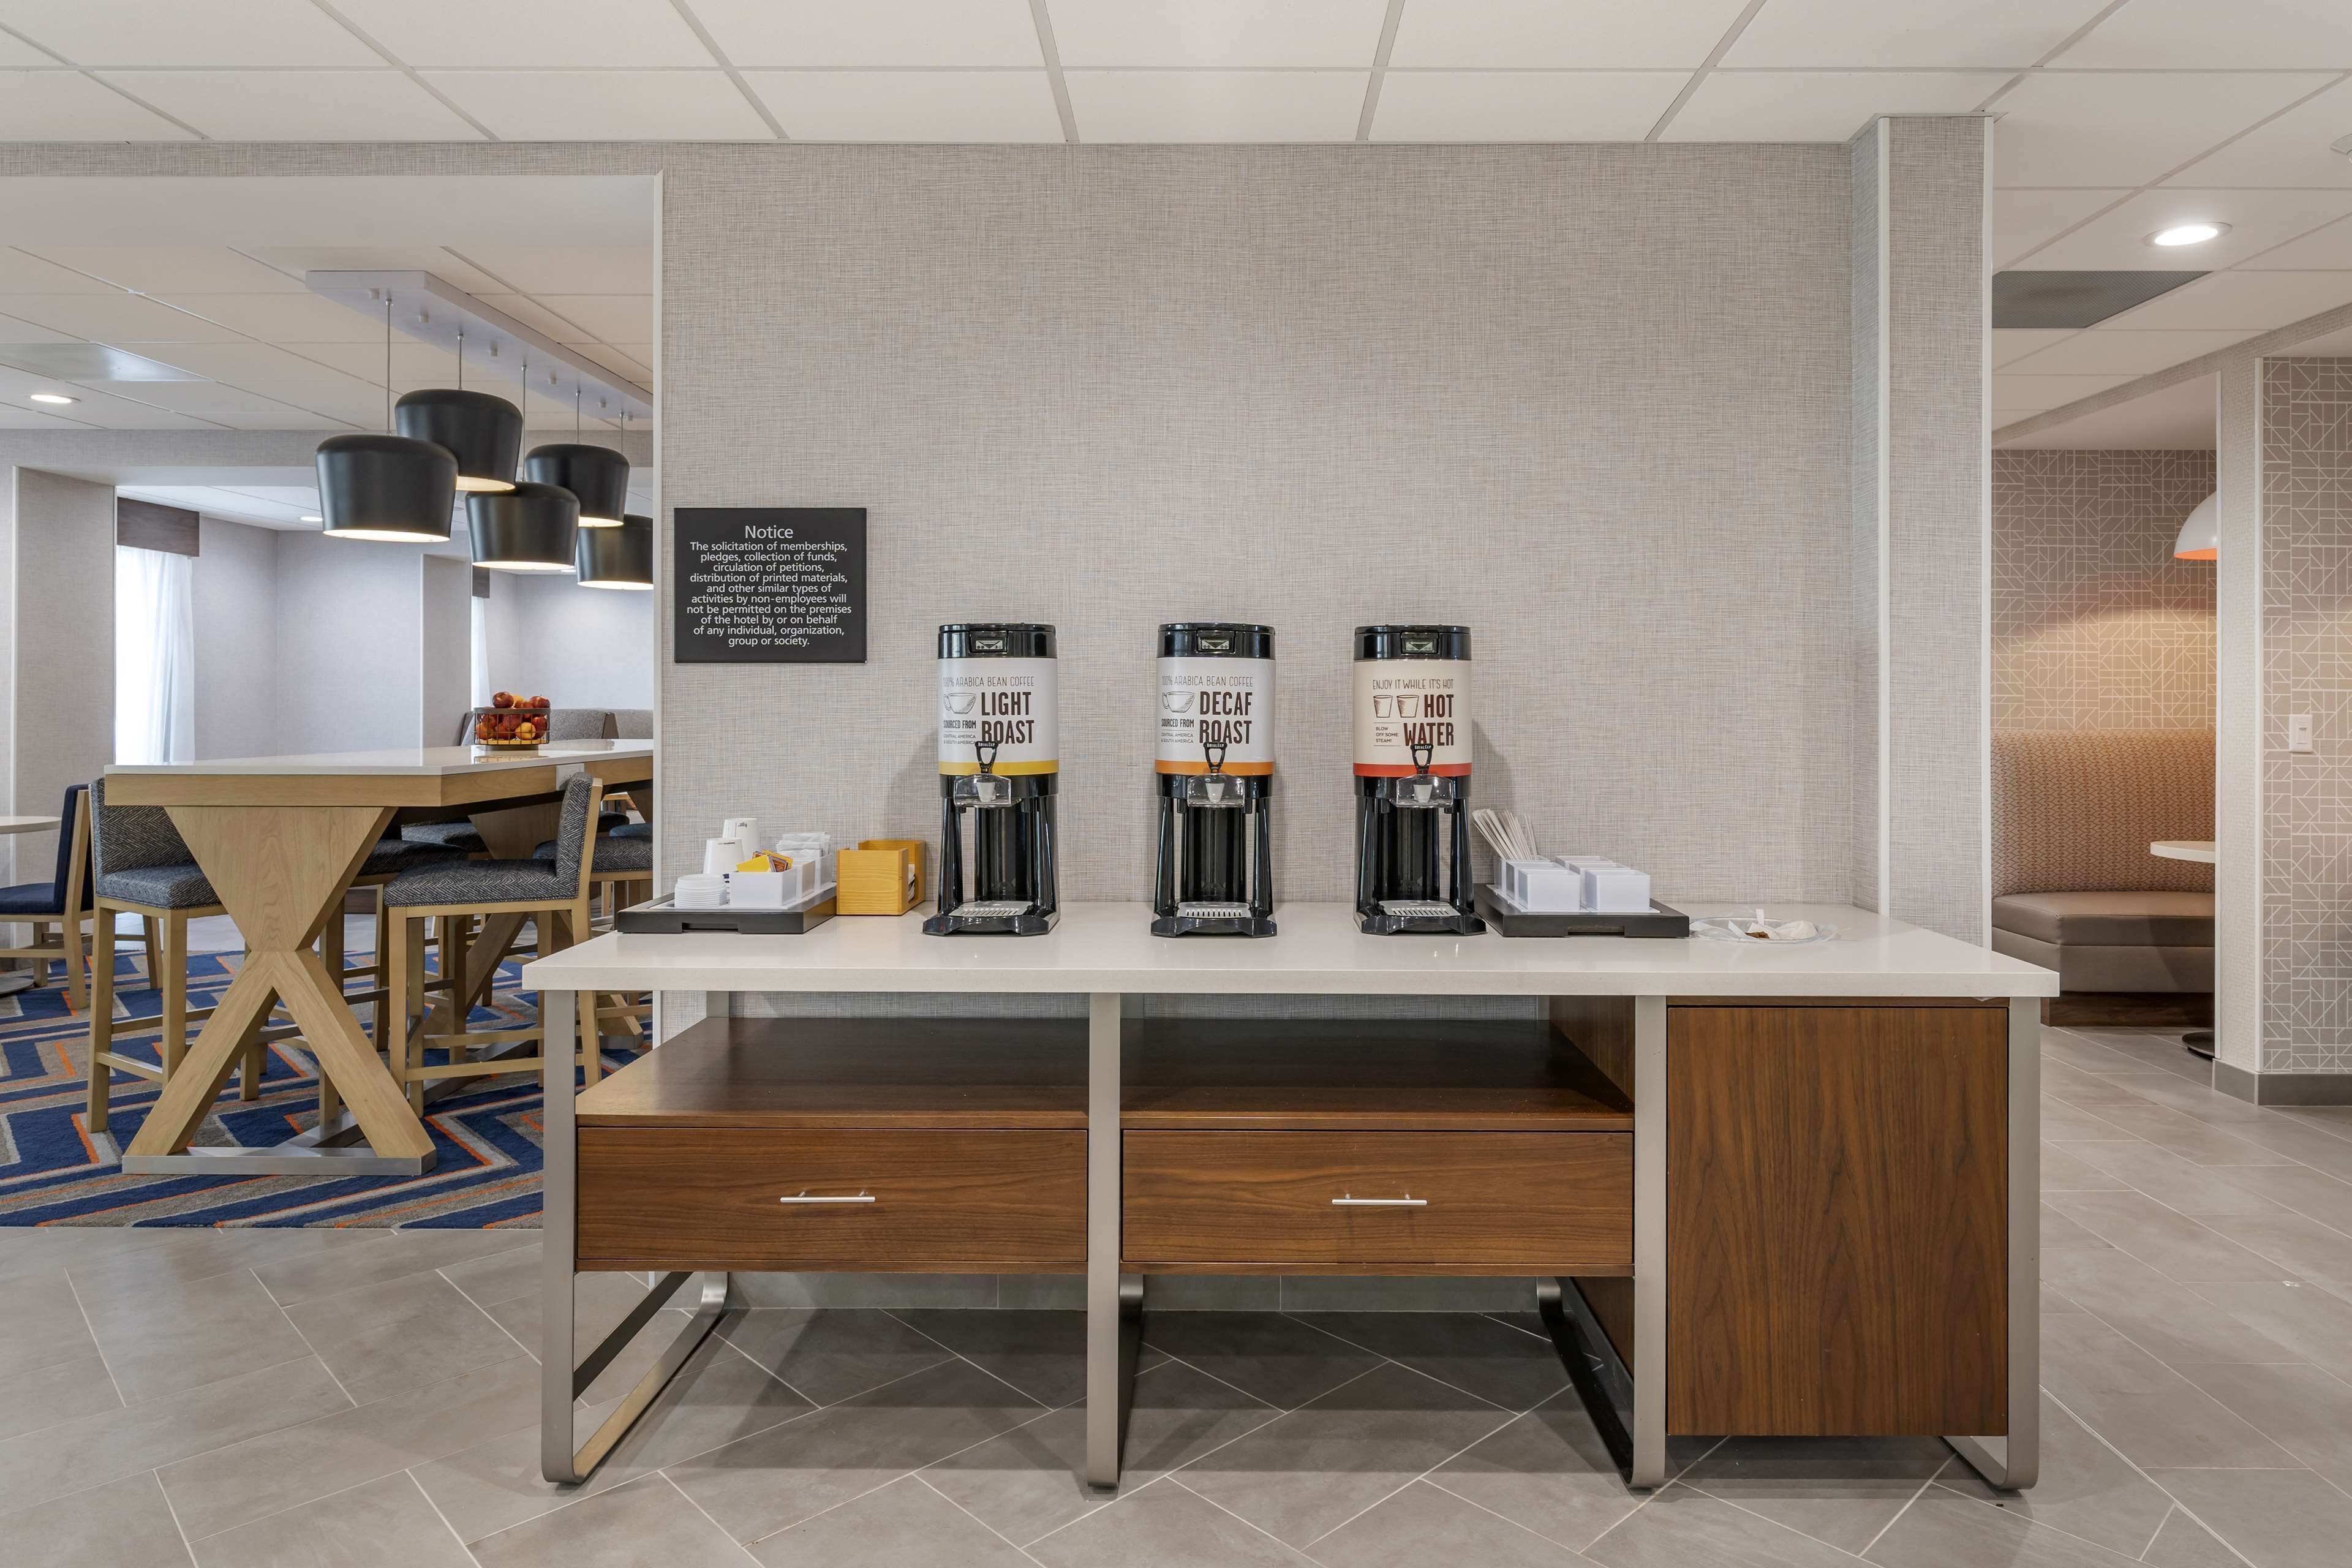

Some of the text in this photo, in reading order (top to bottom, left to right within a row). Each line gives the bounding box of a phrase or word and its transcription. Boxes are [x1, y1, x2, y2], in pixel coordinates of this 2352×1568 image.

[745, 525, 793, 538] Notice
[690, 541, 847, 552] The solicitation of memberships,
[701, 552, 837, 563] pledges, collection of funds,
[714, 562, 824, 573] circulation of petitions,
[690, 573, 847, 584] distribution of printed materials,
[707, 583, 832, 594] and other similar types of
[692, 594, 846, 605] activities by non-employees will
[687, 604, 704, 612] not
[707, 604, 719, 612] be
[723, 604, 771, 615] permitted
[790, 604, 807, 612] the
[810, 604, 851, 615] premises
[701, 614, 712, 623] of
[714, 614, 730, 623] the
[734, 614, 758, 623] hotel
[763, 614, 774, 625] by
[807, 614, 837, 623] behalf
[693, 625, 844, 636] of any individual, organization,
[728, 638, 758, 646] group
[775, 635, 809, 646] society.
[956, 677, 984, 687] ARABICA
[988, 677, 1006, 686] BEAN
[1011, 677, 1034, 686] COFFEE
[1175, 676, 1203, 686] ARABICA
[1207, 676, 1226, 686] BEAN
[1229, 677, 1253, 687] COFFEE
[1373, 679, 1453, 689] ENJOY IT WHILE IT'S HOT
[982, 692, 1031, 715] LIGHT
[1200, 692, 1252, 715] DECAF
[1425, 695, 1453, 718] HOT
[962, 720, 976, 729] FROM
[982, 720, 1034, 744] ROAST
[1200, 720, 1252, 744] ROAST
[1404, 723, 1453, 746] WATER
